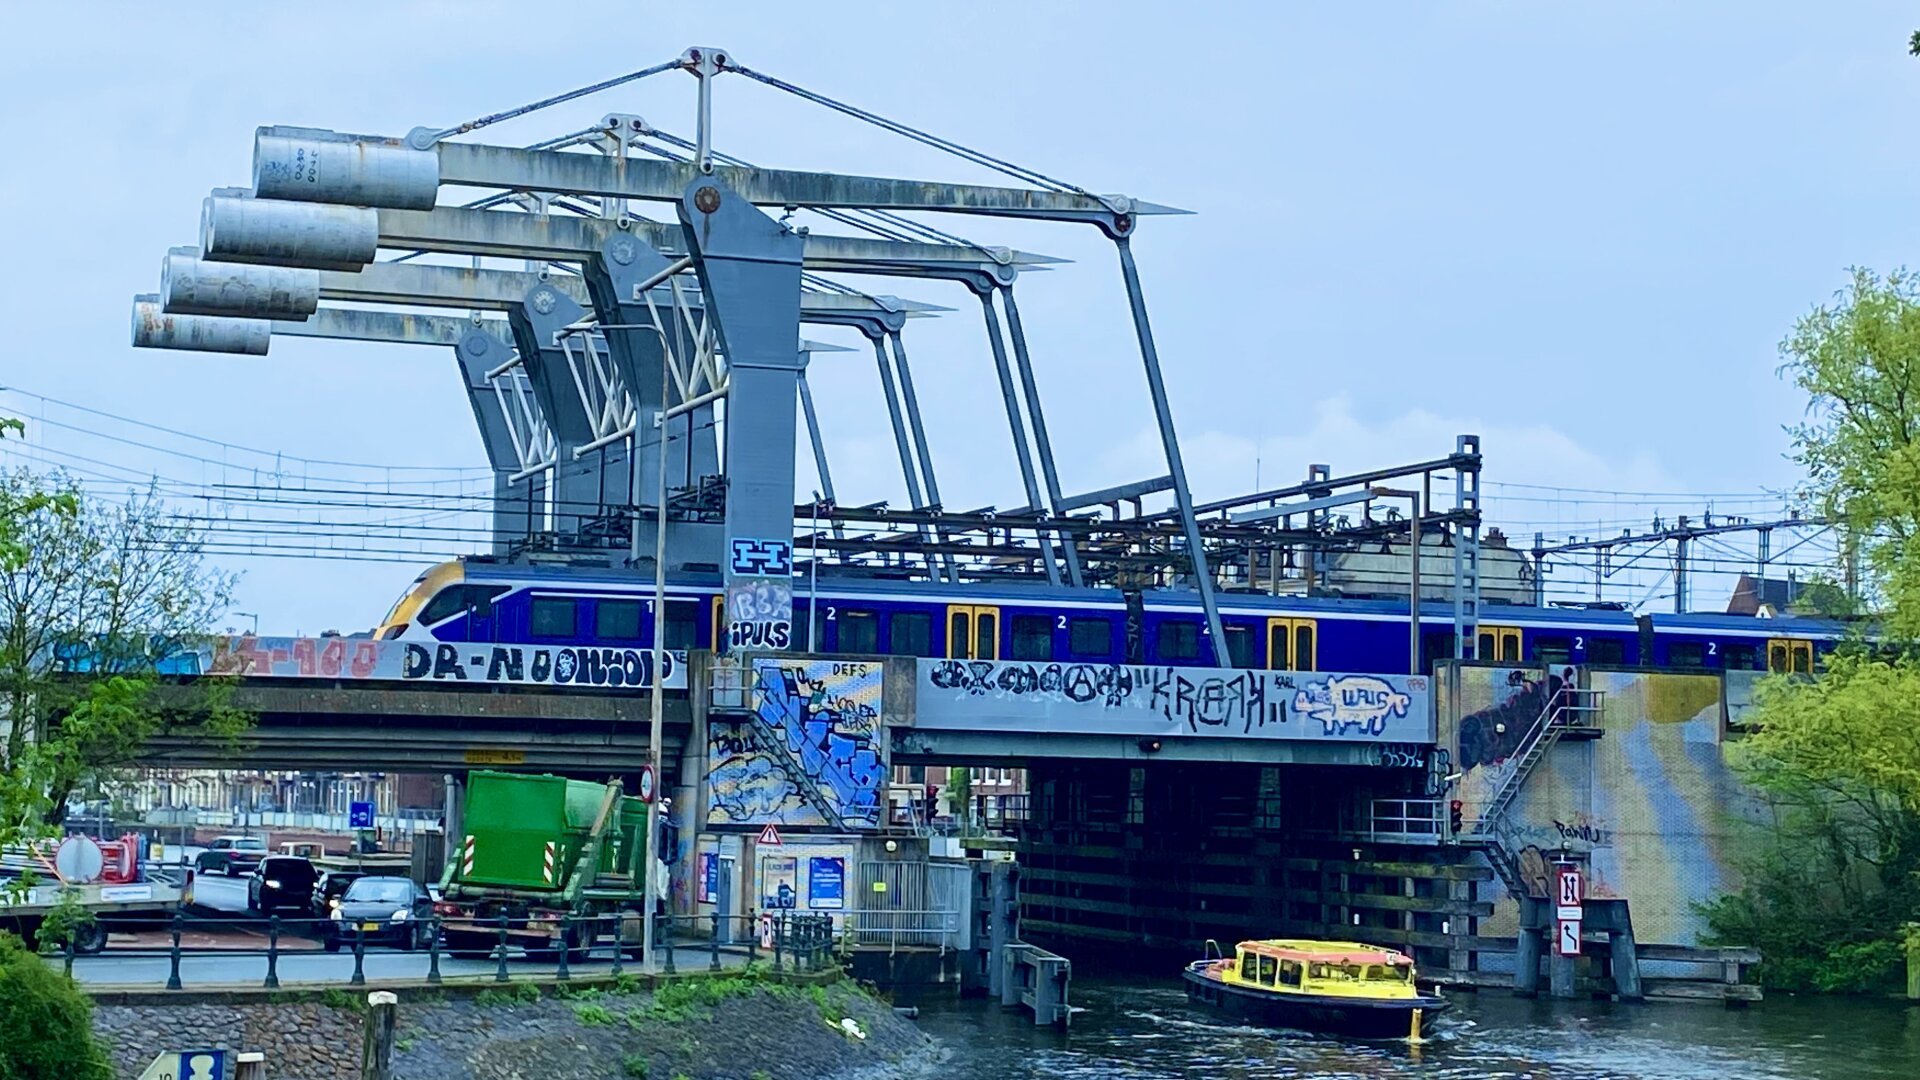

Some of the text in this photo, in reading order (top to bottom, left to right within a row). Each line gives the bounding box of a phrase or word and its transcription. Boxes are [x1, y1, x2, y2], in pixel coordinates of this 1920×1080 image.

[646, 600, 653, 613] 1
[826, 606, 836, 620] 2
[1057, 615, 1067, 629] 2
[1574, 636, 1584, 650] 2
[1707, 642, 1717, 655] 2
